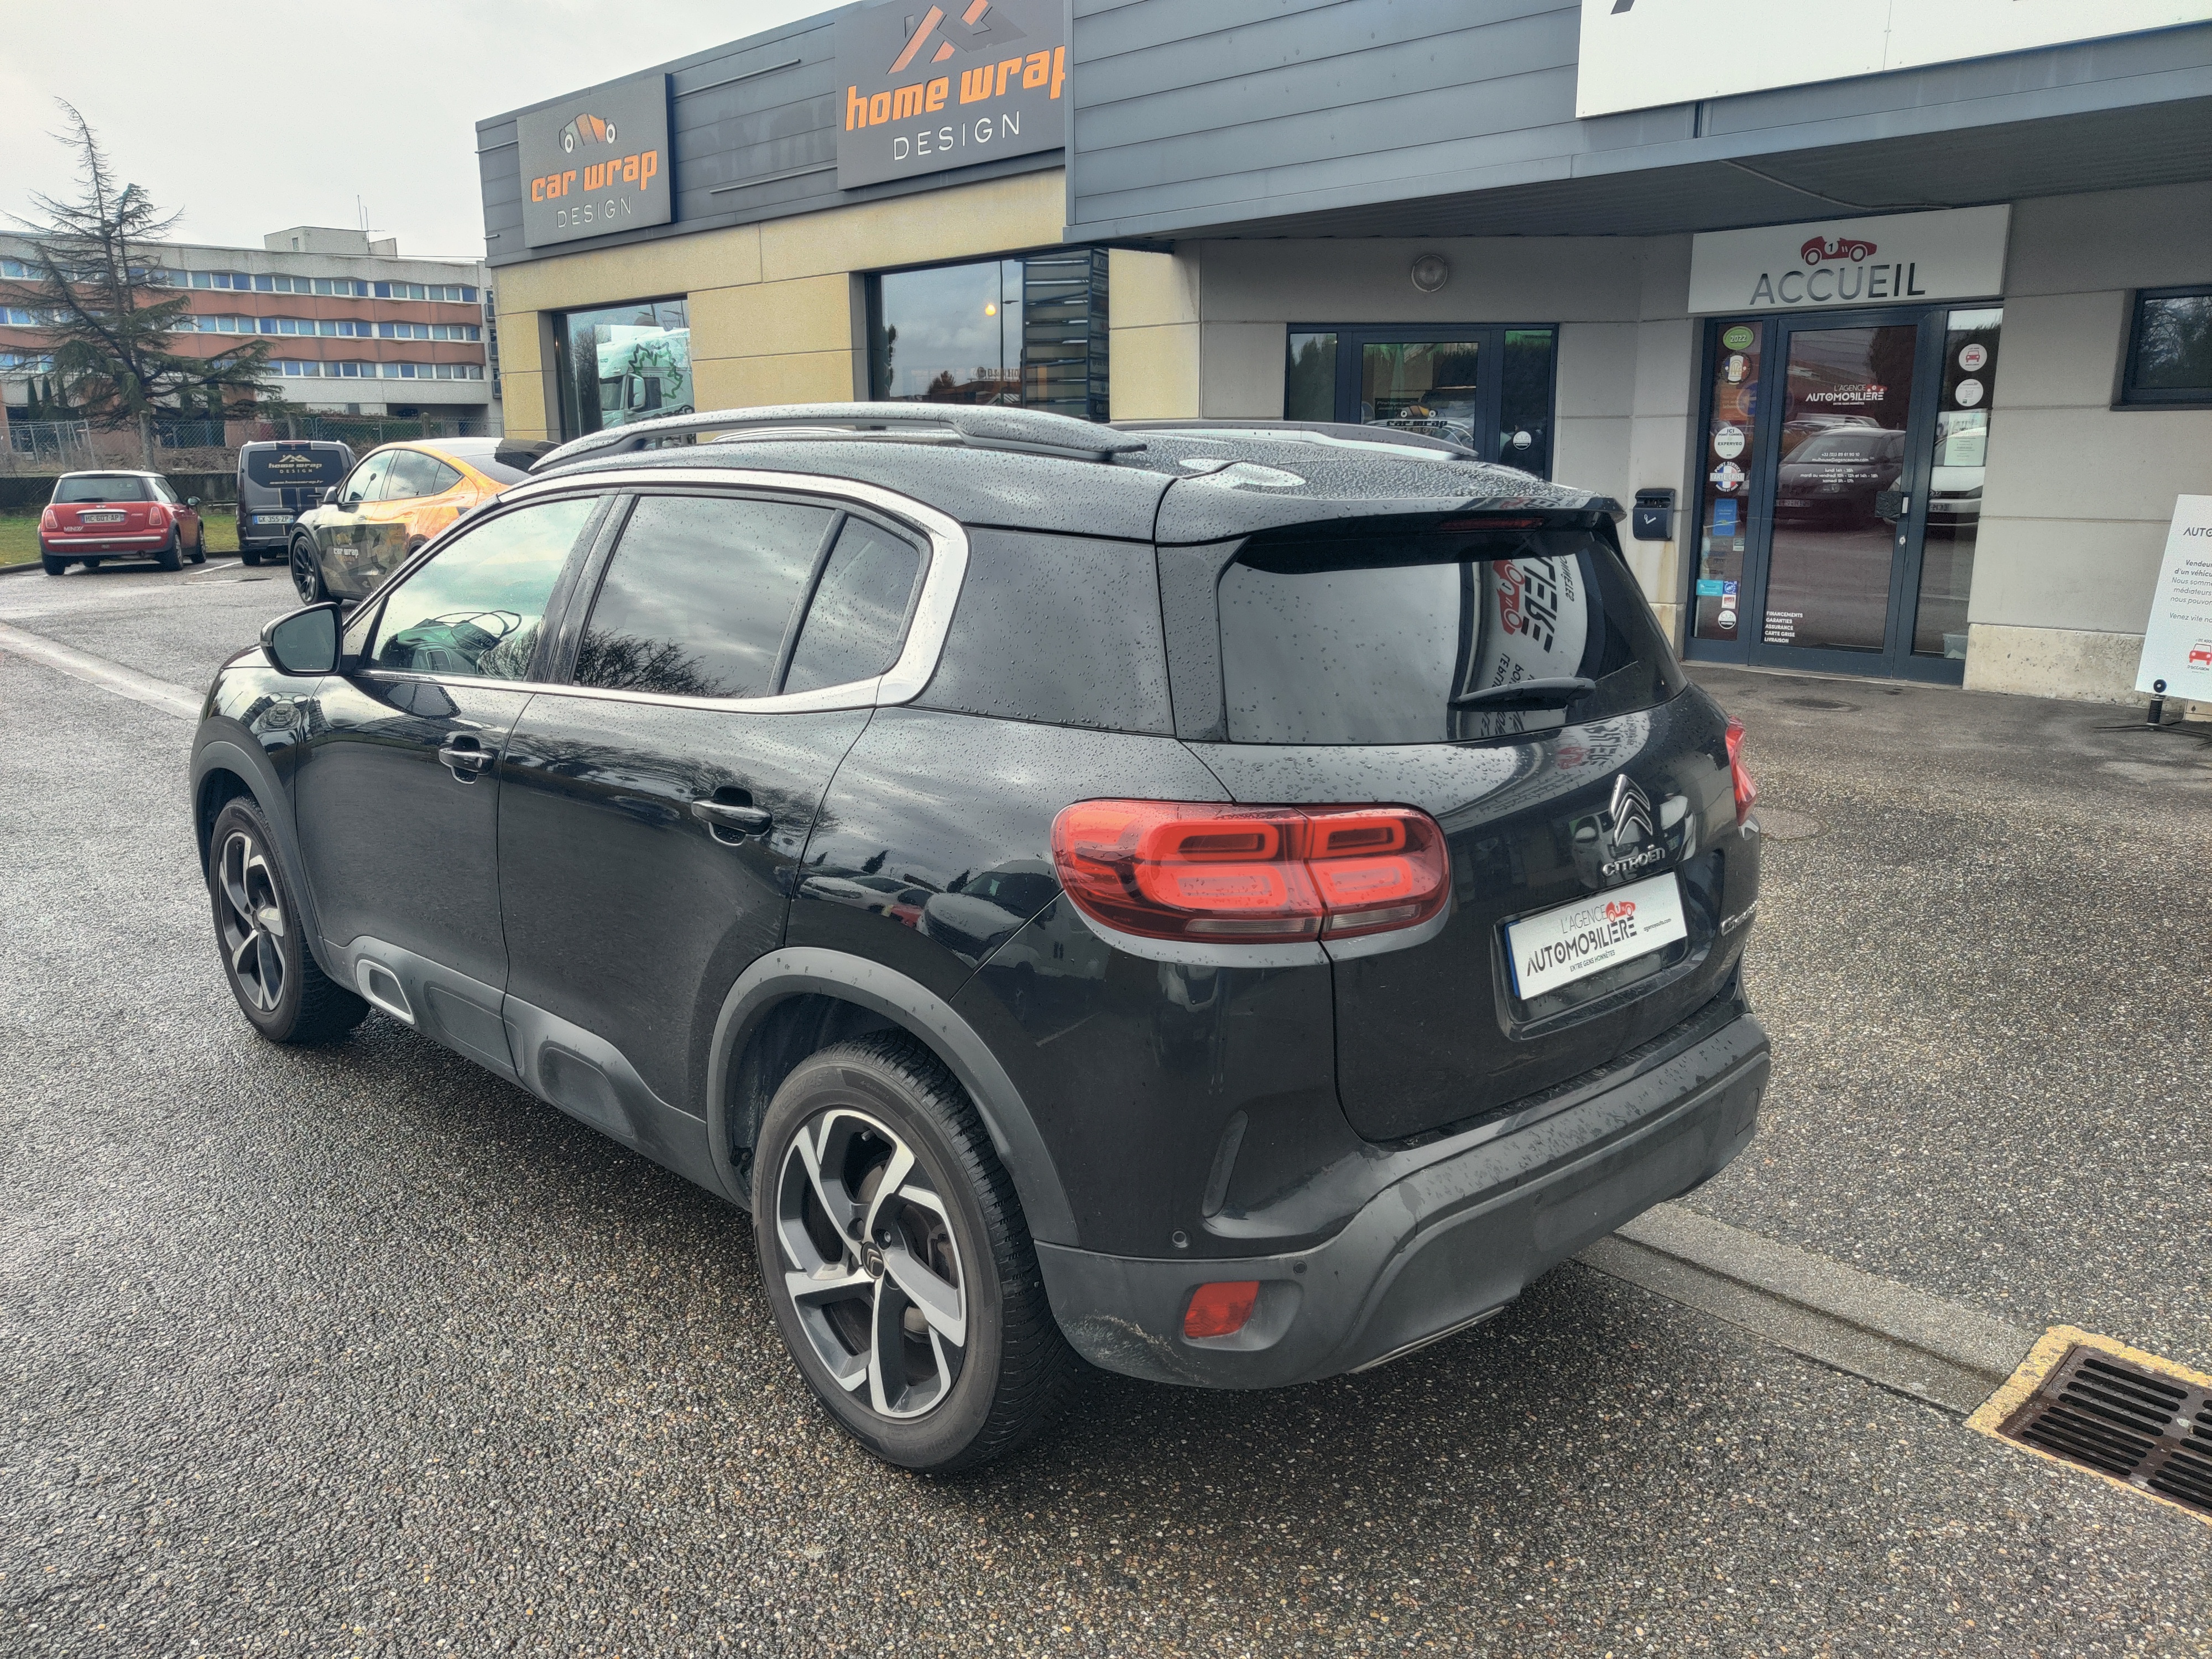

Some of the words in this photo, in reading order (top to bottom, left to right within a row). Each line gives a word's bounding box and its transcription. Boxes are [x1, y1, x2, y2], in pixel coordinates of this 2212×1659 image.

[846, 76, 949, 131] home
[894, 111, 1020, 161] DESIGN
[531, 170, 576, 202] car
[583, 150, 657, 191] wrap
[557, 196, 631, 228] DESIGN
[1749, 263, 1926, 305] ACCUEIL
[1714, 461, 1726, 473] POINT
[2174, 587, 2211, 596] médiateurs
[1561, 904, 1607, 933] L'AGENCE
[1570, 962, 1583, 972] ENTRE
[1583, 957, 1594, 967] GENS
